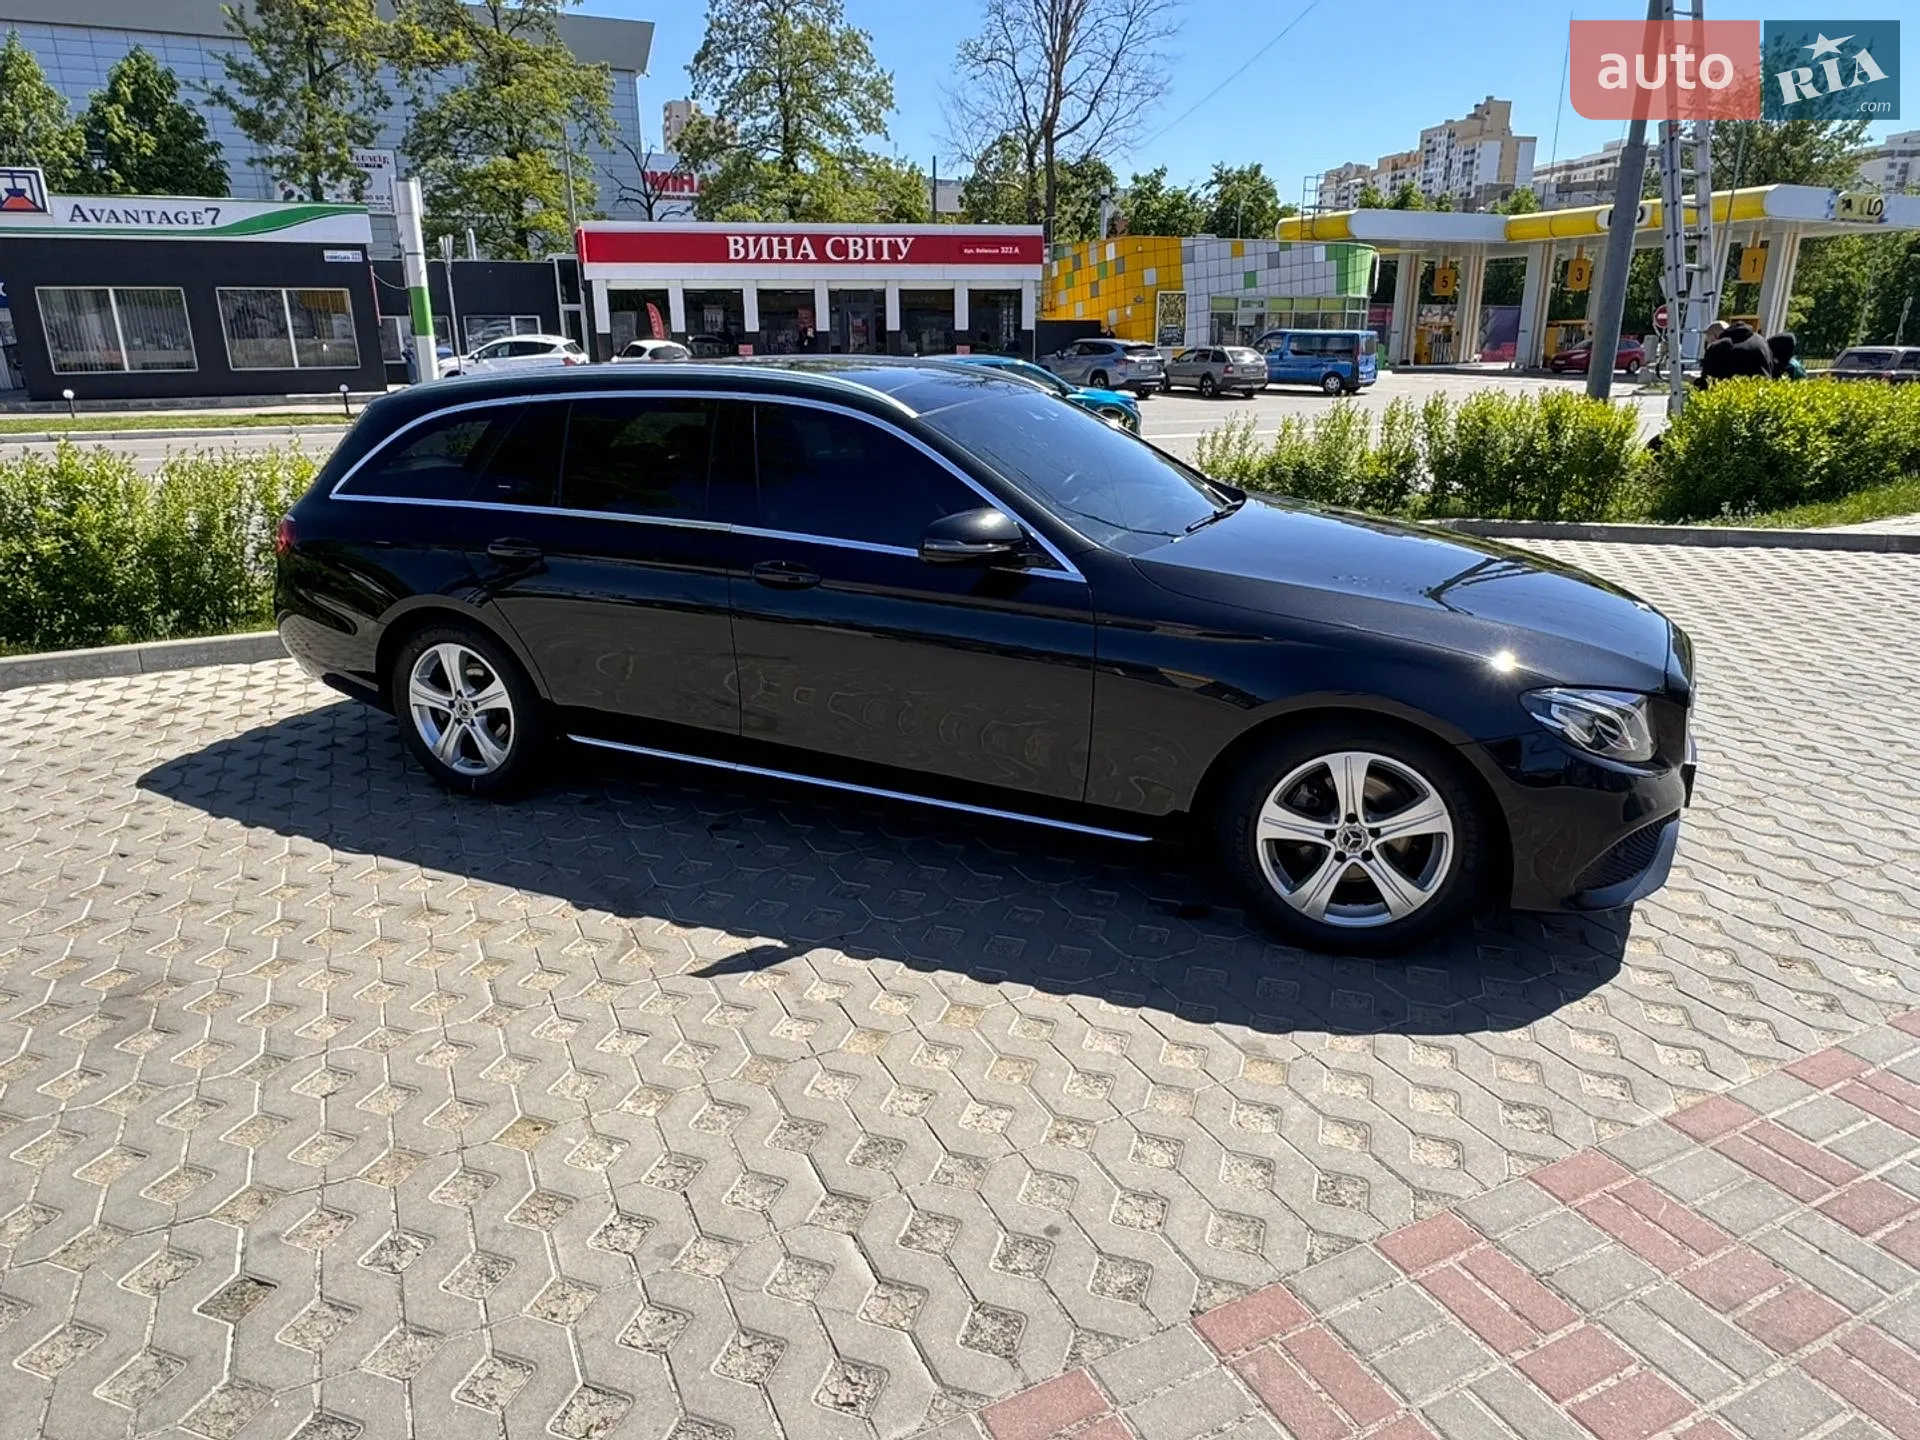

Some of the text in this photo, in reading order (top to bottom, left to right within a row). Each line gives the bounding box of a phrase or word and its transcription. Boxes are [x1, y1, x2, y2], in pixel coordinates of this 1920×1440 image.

[727, 235, 915, 262] ВИНА СВІТУ
[1575, 266, 1583, 283] 3
[1752, 259, 1757, 274] 1
[1441, 275, 1448, 288] 5
